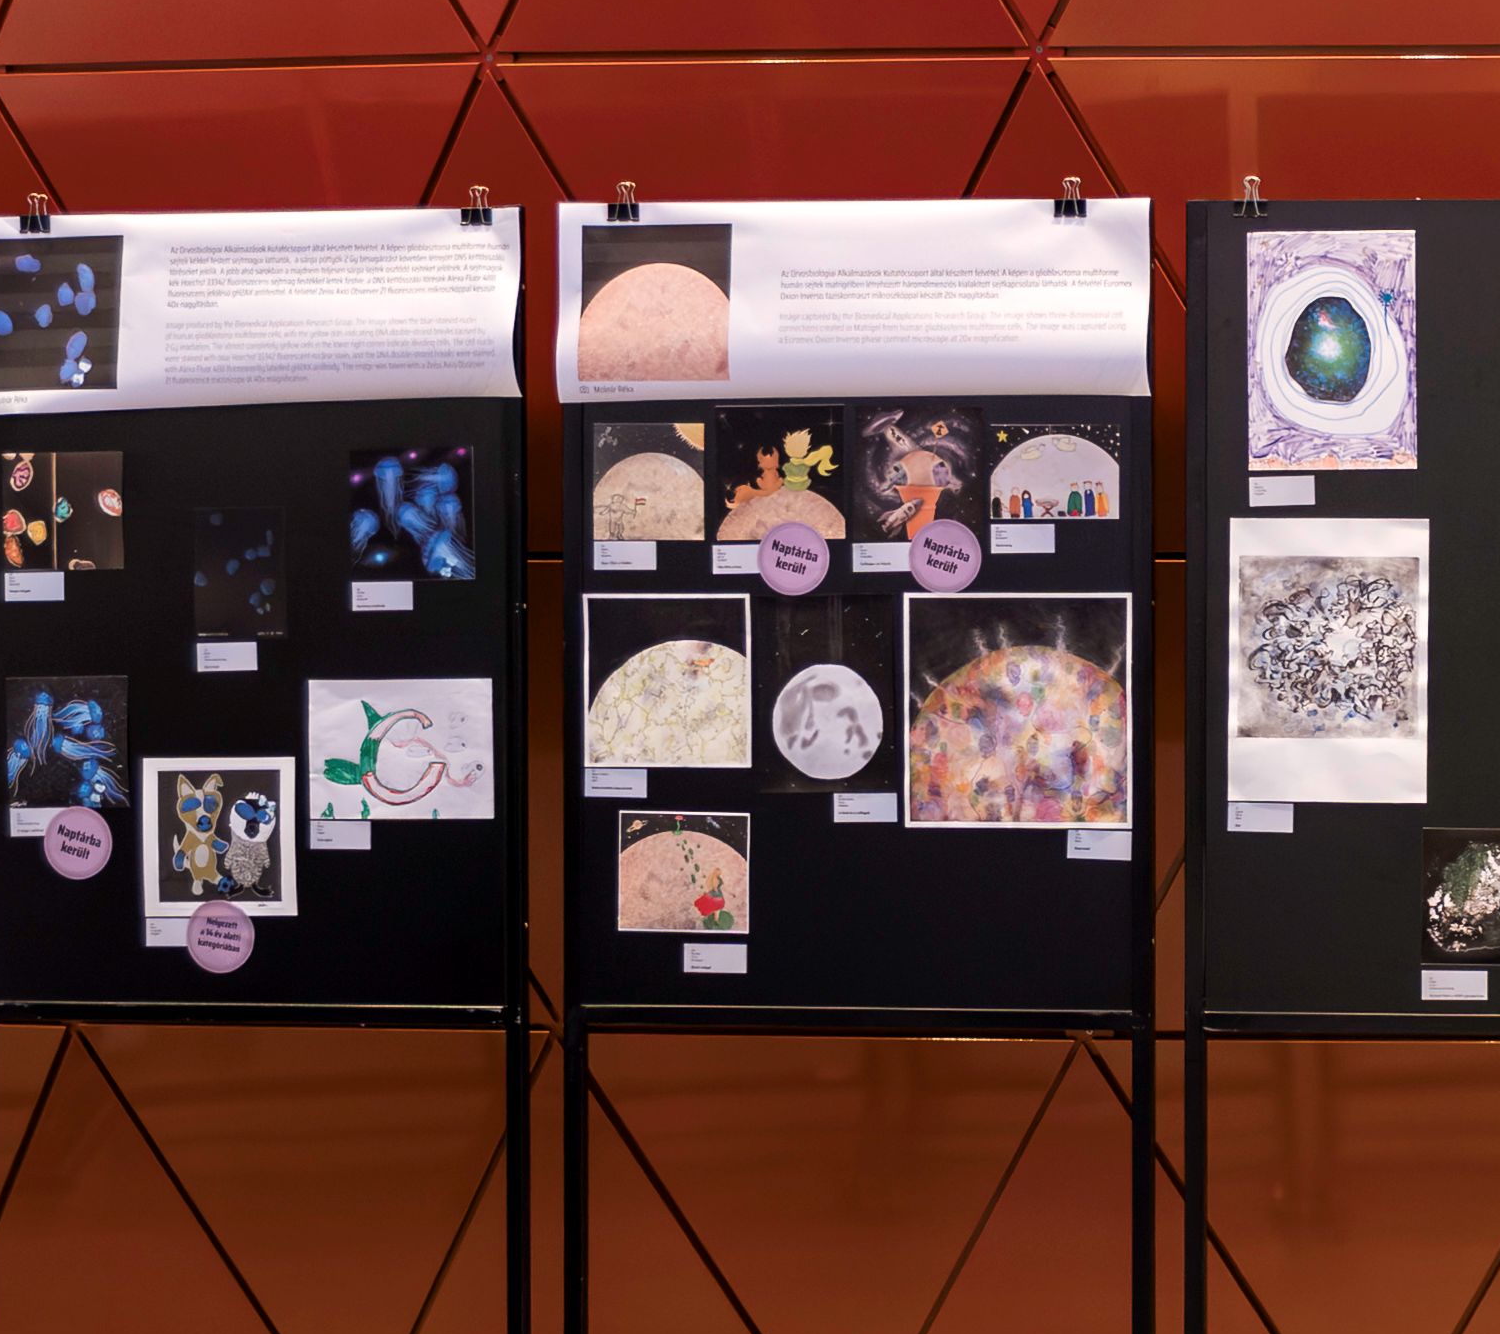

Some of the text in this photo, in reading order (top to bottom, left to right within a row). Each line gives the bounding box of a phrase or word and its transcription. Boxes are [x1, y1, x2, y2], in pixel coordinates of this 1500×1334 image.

[772, 539, 818, 562] Naptárba
[924, 537, 970, 562] Naptárba
[776, 556, 806, 575] került
[926, 554, 958, 574] került
[57, 824, 102, 848] Naptárba
[60, 841, 90, 860] került
